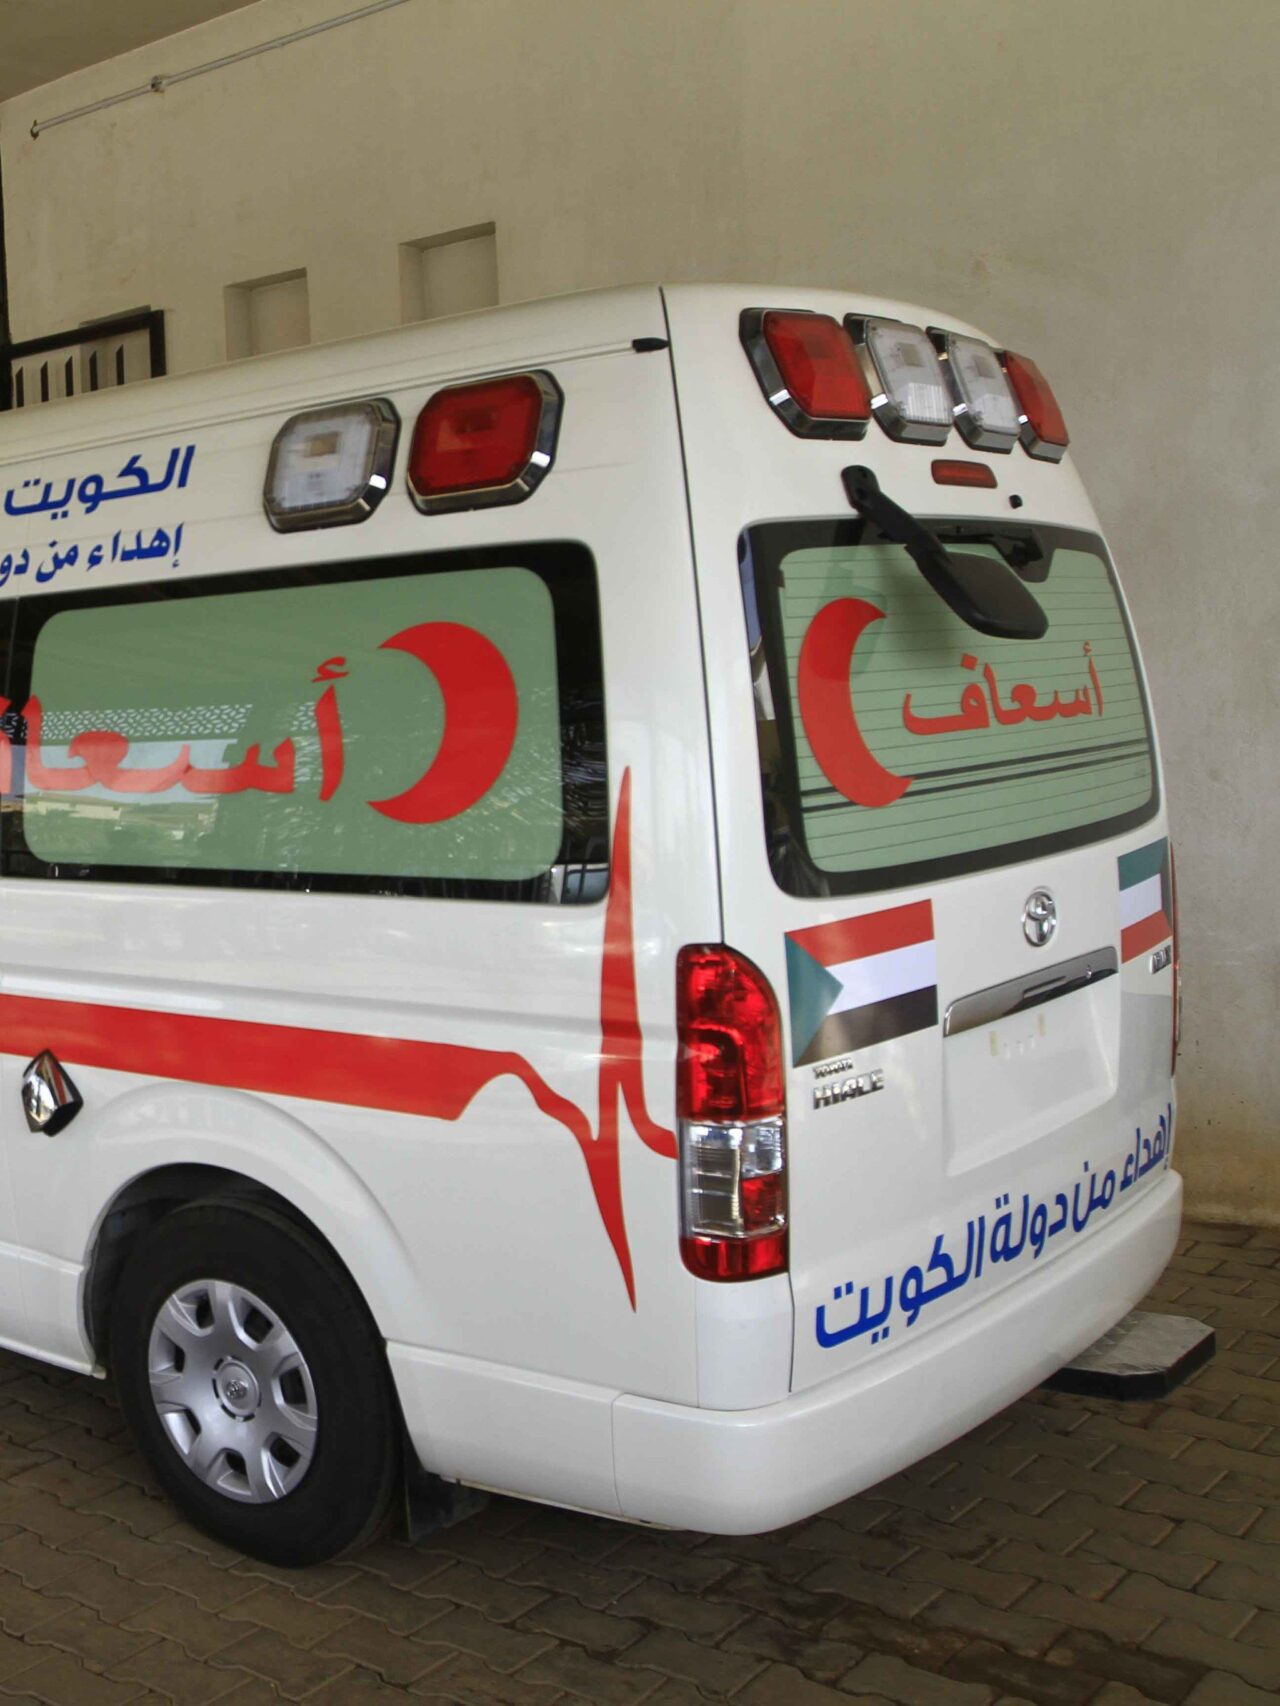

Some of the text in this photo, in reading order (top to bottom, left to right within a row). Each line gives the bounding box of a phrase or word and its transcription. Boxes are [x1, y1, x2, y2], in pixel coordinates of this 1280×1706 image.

[4, 444, 196, 520] الكويت
[35, 540, 79, 583] من
[87, 522, 184, 572] إهداء
[902, 641, 1105, 736] أسعاف
[815, 1103, 1172, 1349] إهداء من دولة الكويت
